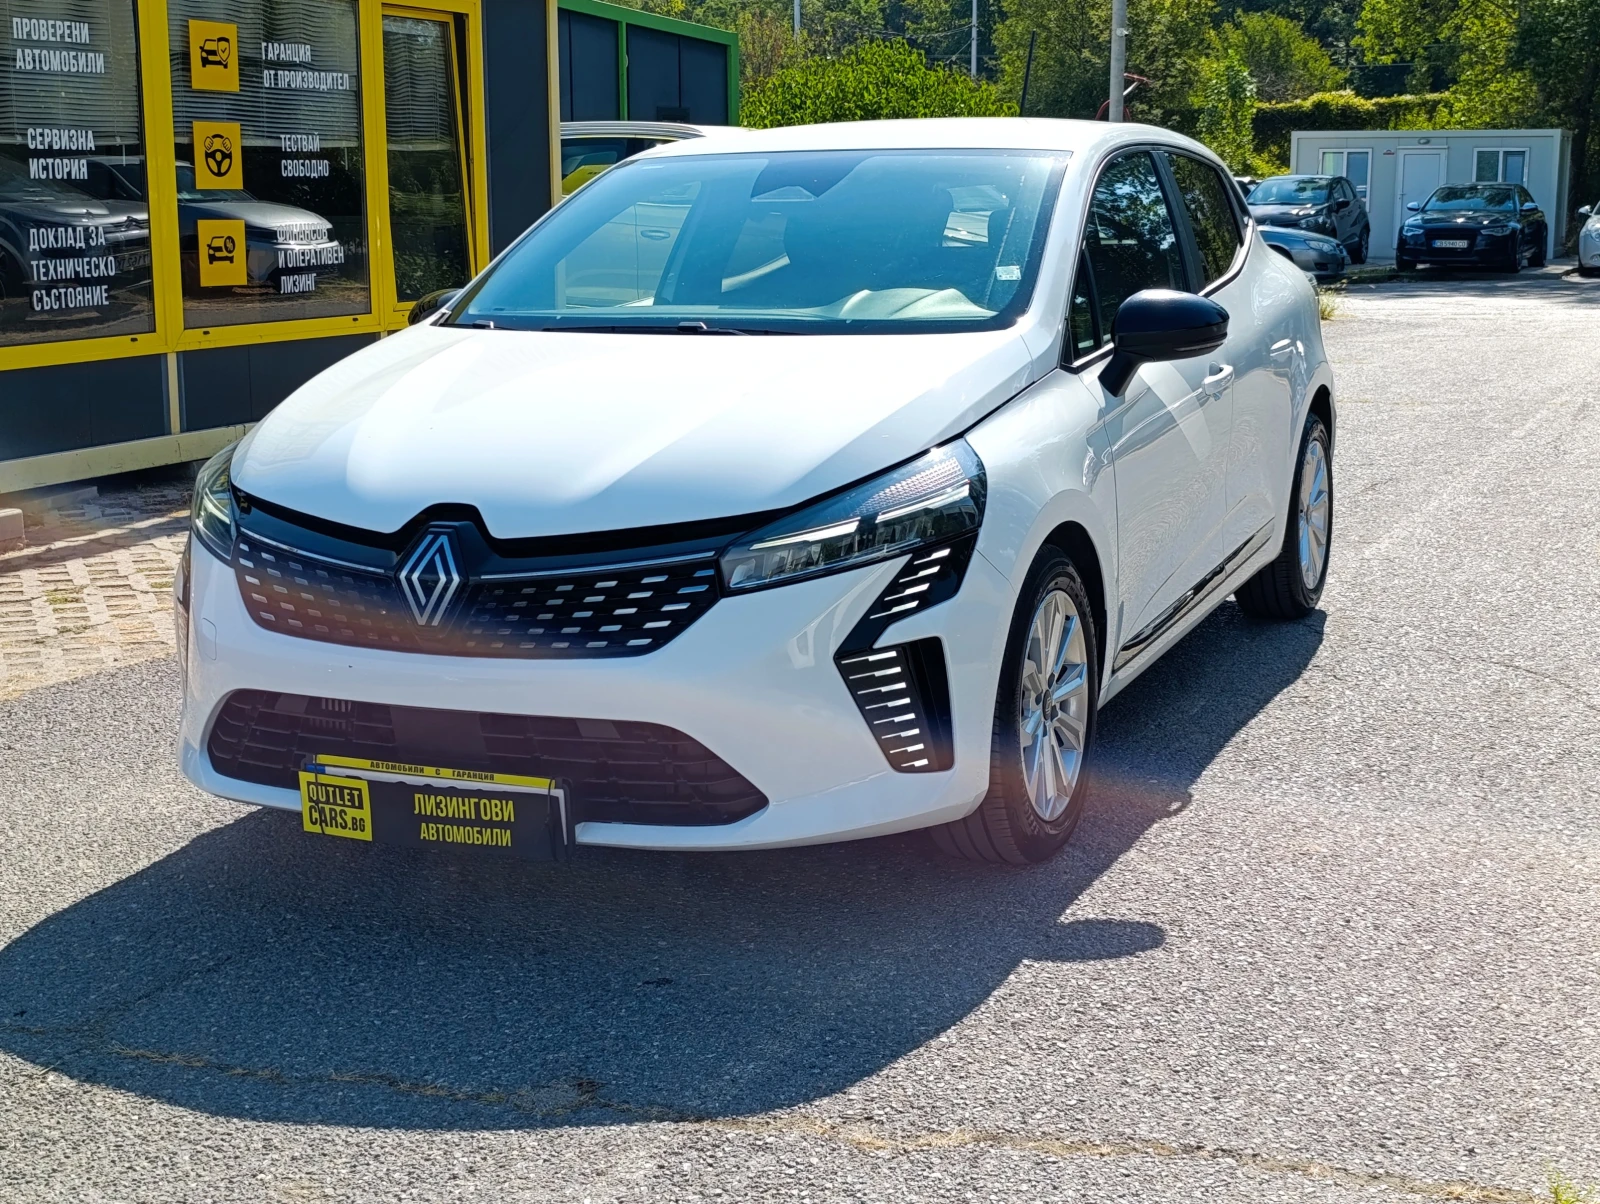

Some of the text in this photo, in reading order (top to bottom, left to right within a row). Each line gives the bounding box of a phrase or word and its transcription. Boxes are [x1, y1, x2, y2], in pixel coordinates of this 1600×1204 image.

[12, 17, 90, 44] ПРОВЕРЕНИ
[15, 48, 105, 74] АВТОМОБИЛИ
[261, 42, 312, 63] ГАРАНЦИЯ
[263, 69, 349, 91] ОТ ПРОИЗВОДИТЕЛ
[27, 128, 95, 151] СЕРВИЗНА
[280, 132, 321, 153] ТЕСТВАЙ
[29, 158, 88, 180] ИСТОРИЯ
[281, 159, 330, 178] СВОБОДНО
[29, 226, 106, 251] ДОКЛАД ЗА
[31, 256, 116, 281] ТЕХНИЧЕСКО
[278, 246, 345, 268] И ОПЕРАТИВЕН
[280, 273, 317, 294] ЛИЗИНГ
[33, 285, 109, 311] СЪСТОЯНИЕ
[369, 760, 495, 782] АВТОМОБИЛИ С ГАРАНЦИЯ
[309, 784, 360, 807] OUTLET
[309, 803, 366, 832] CARS.BG
[413, 793, 515, 822] ЛИЗИНГОВИ
[420, 822, 512, 847] АВТОМОБИЛИ
